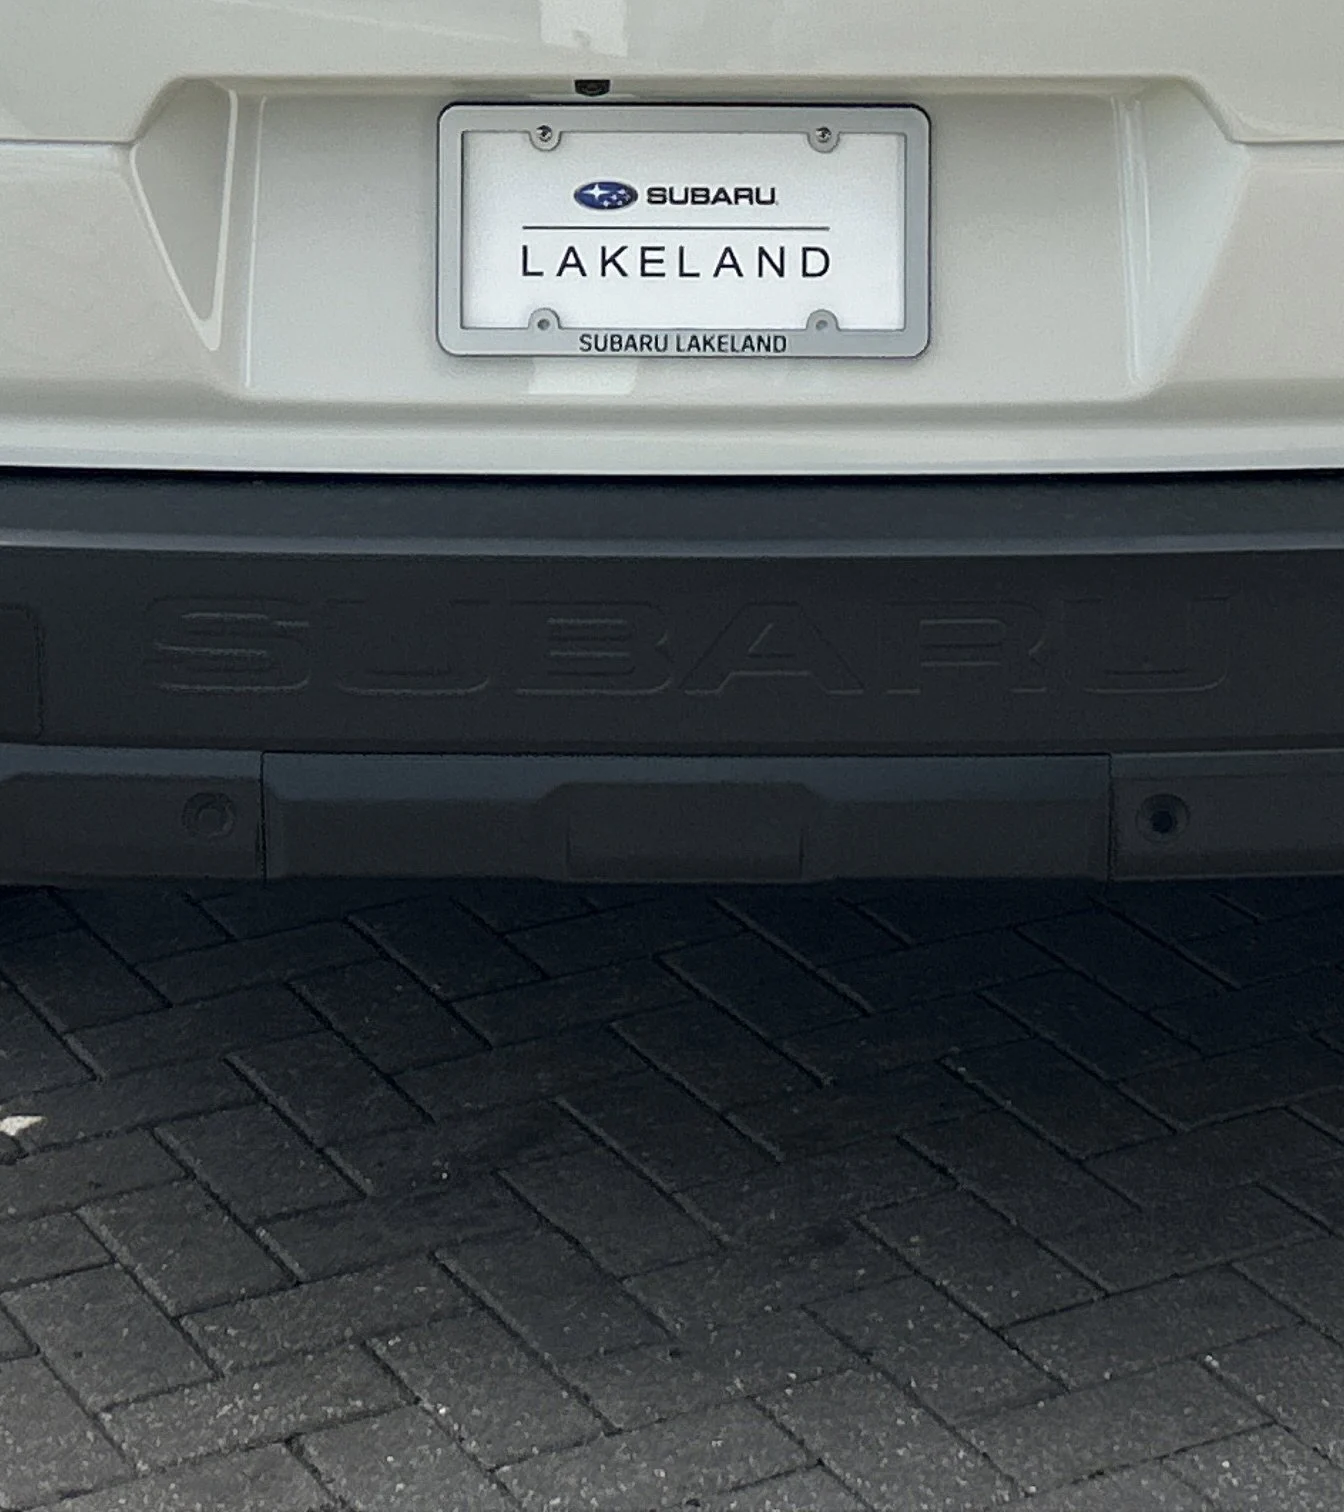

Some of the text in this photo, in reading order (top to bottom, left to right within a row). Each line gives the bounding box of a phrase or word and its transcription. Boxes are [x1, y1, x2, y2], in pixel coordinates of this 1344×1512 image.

[646, 186, 778, 207] SUBARU
[521, 244, 833, 279] LAKELAND
[578, 333, 788, 355] SUBARU LAKELAND
[143, 598, 1232, 696] SUBARU
